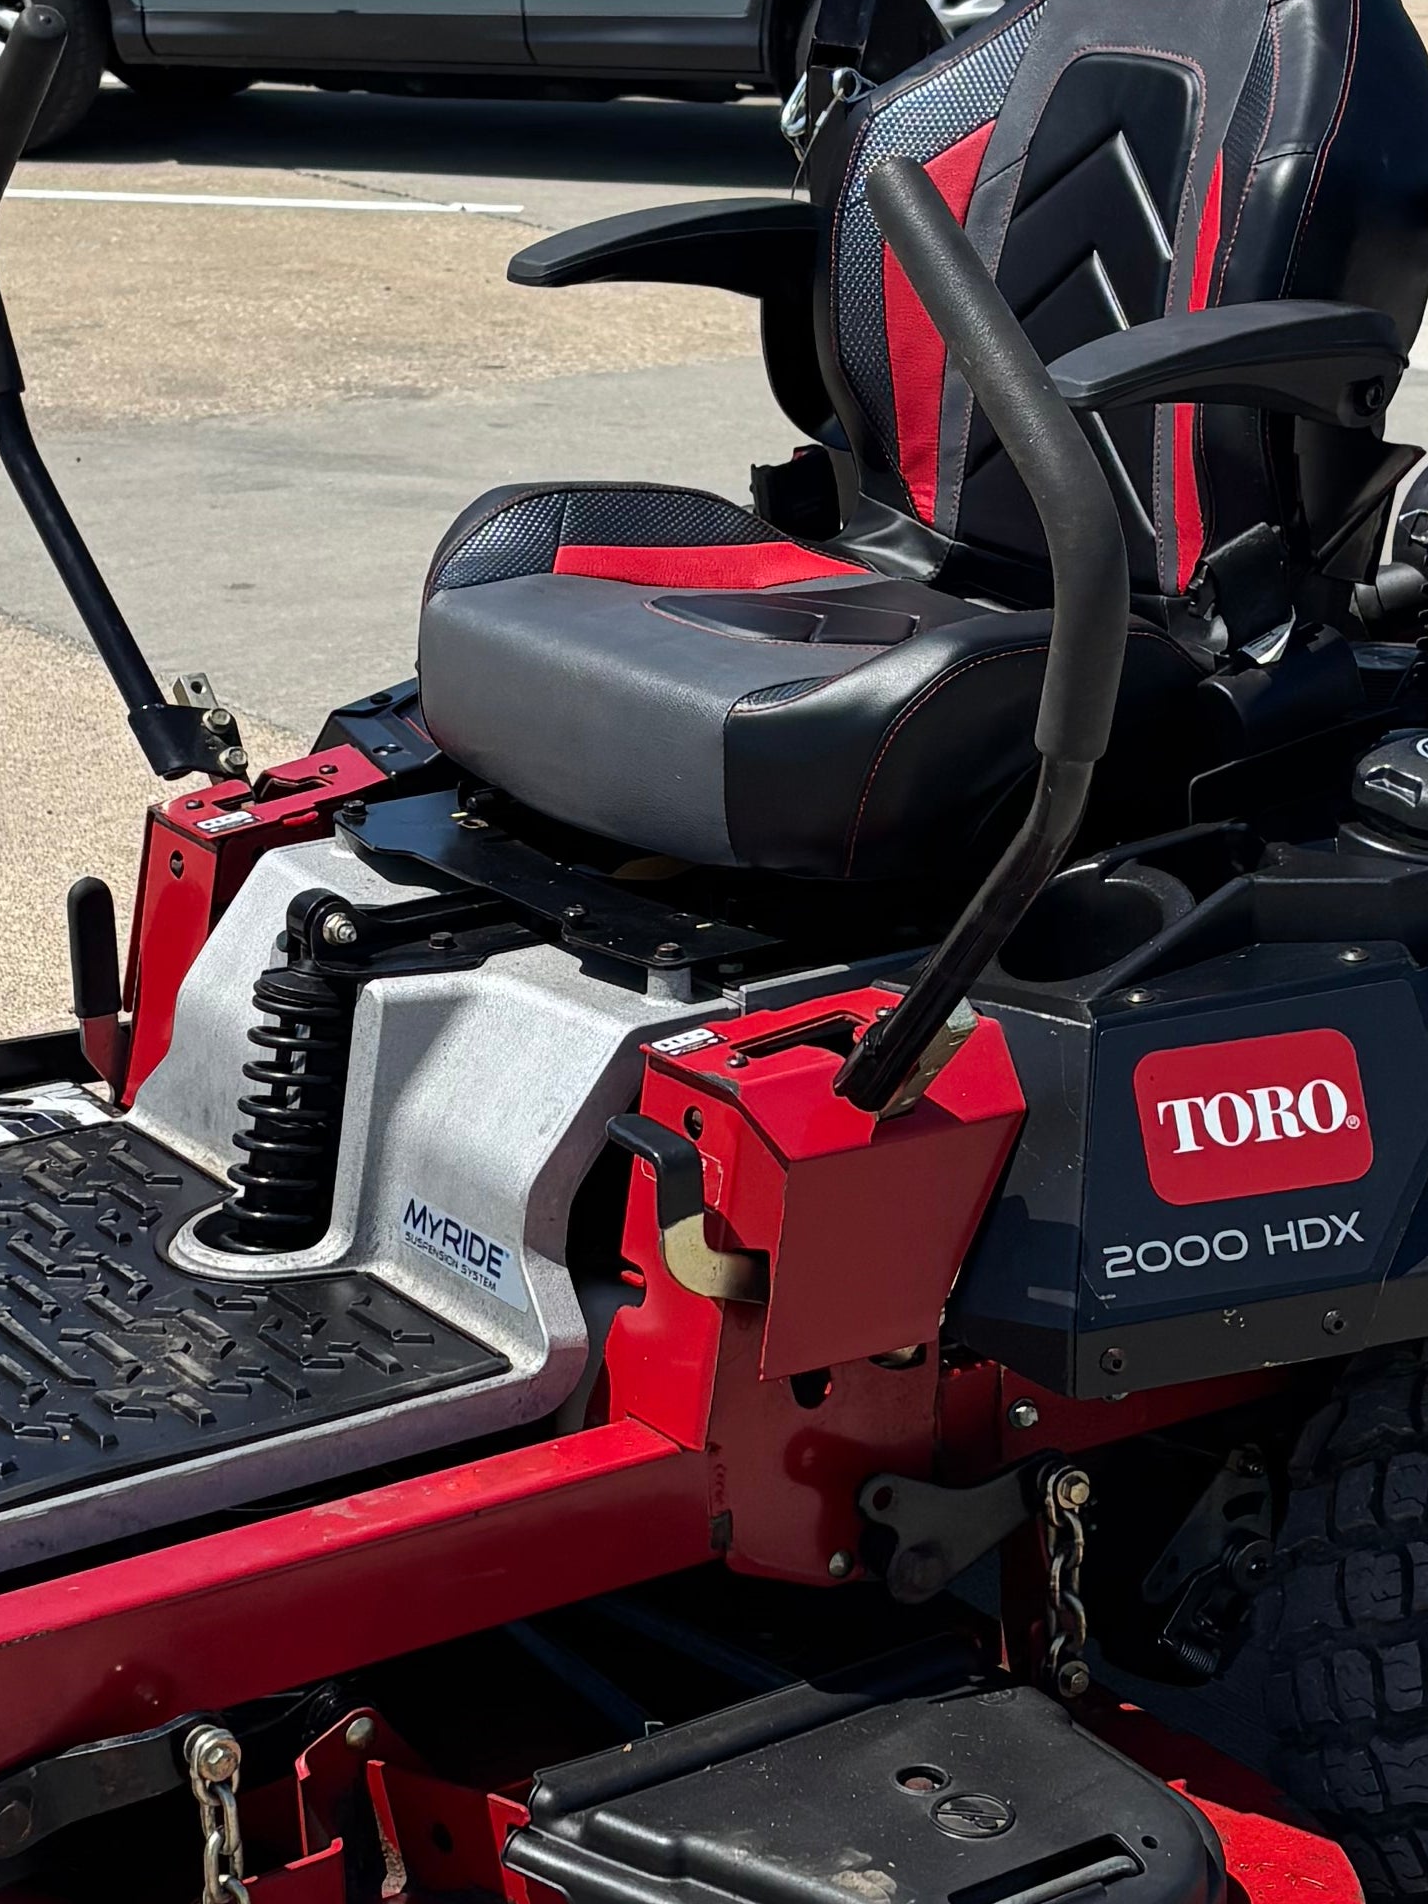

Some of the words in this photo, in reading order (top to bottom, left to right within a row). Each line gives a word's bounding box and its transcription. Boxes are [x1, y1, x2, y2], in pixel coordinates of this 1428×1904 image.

[1157, 1078, 1348, 1154] TORO
[405, 1230, 459, 1270] SUSPENSION
[461, 1263, 497, 1293] SYSTEM
[1102, 1229, 1249, 1279] 2000
[1264, 1211, 1365, 1255] HDX
